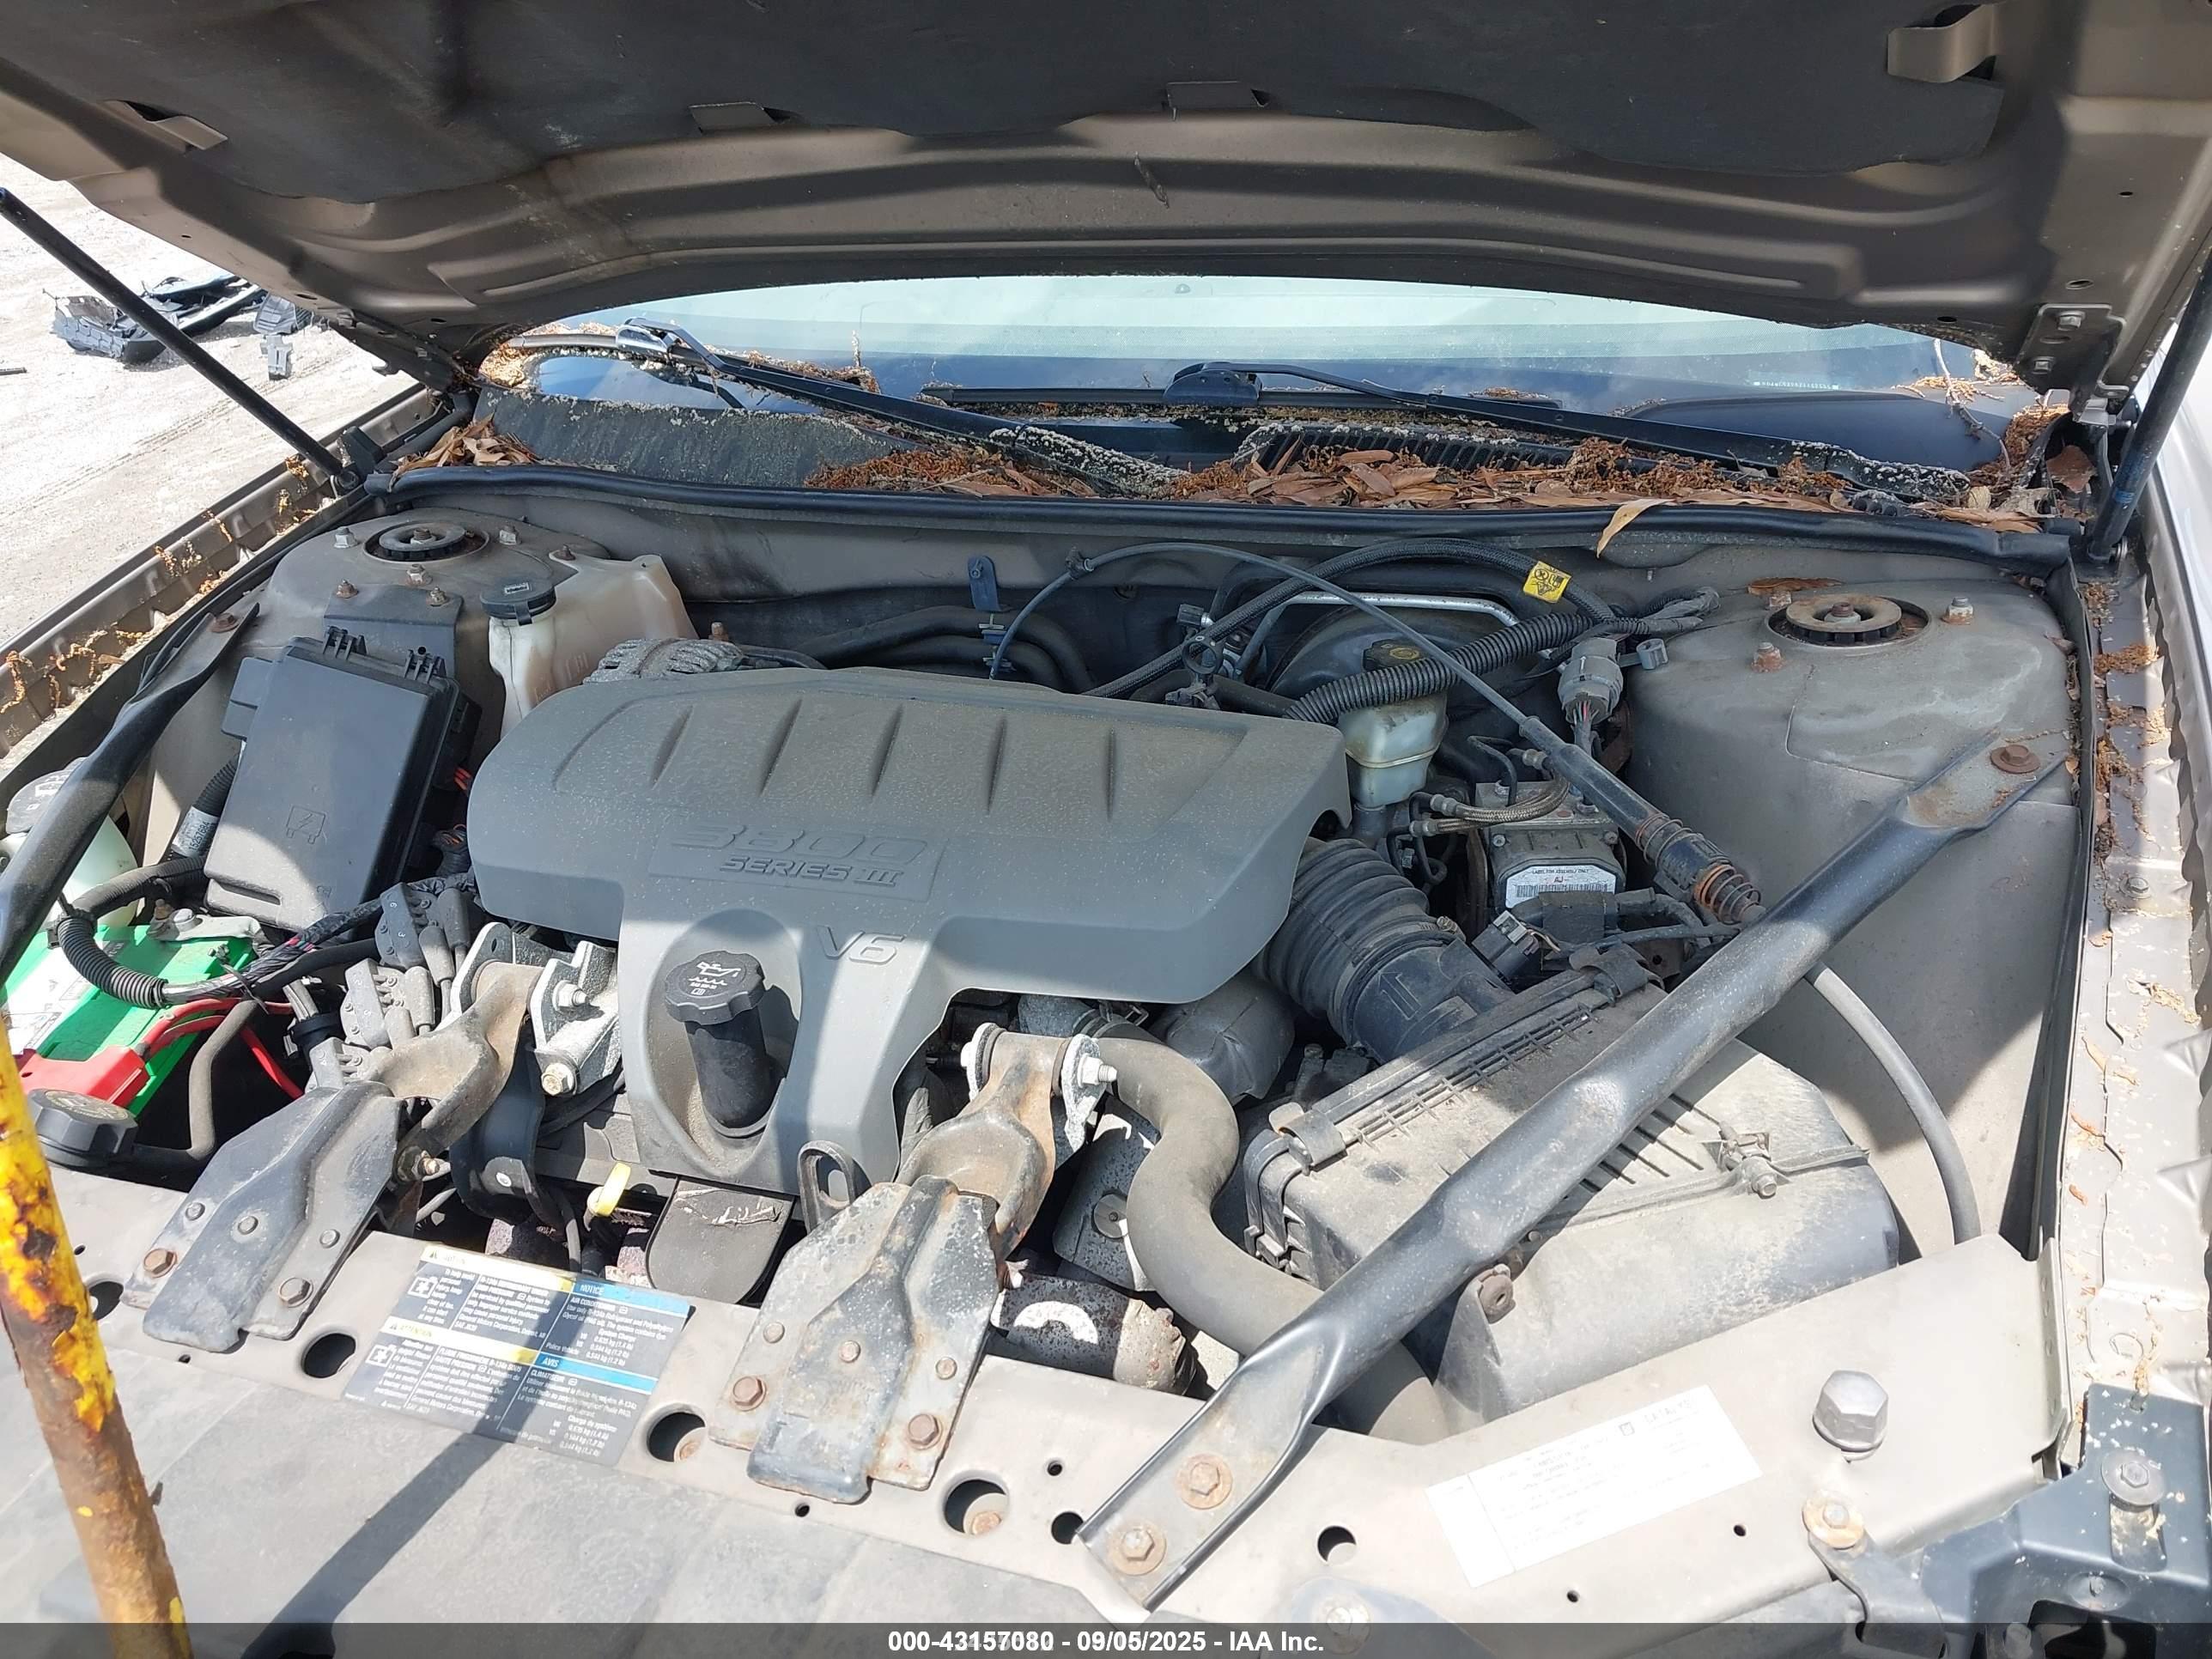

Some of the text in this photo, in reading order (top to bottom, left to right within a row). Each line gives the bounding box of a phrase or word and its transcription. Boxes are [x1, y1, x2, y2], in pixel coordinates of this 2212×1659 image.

[671, 823, 929, 866] 3800
[720, 856, 904, 886] SERIES III
[816, 925, 907, 964] V6
[580, 1284, 605, 1294] NOTICE
[542, 1358, 559, 1366] AVIS
